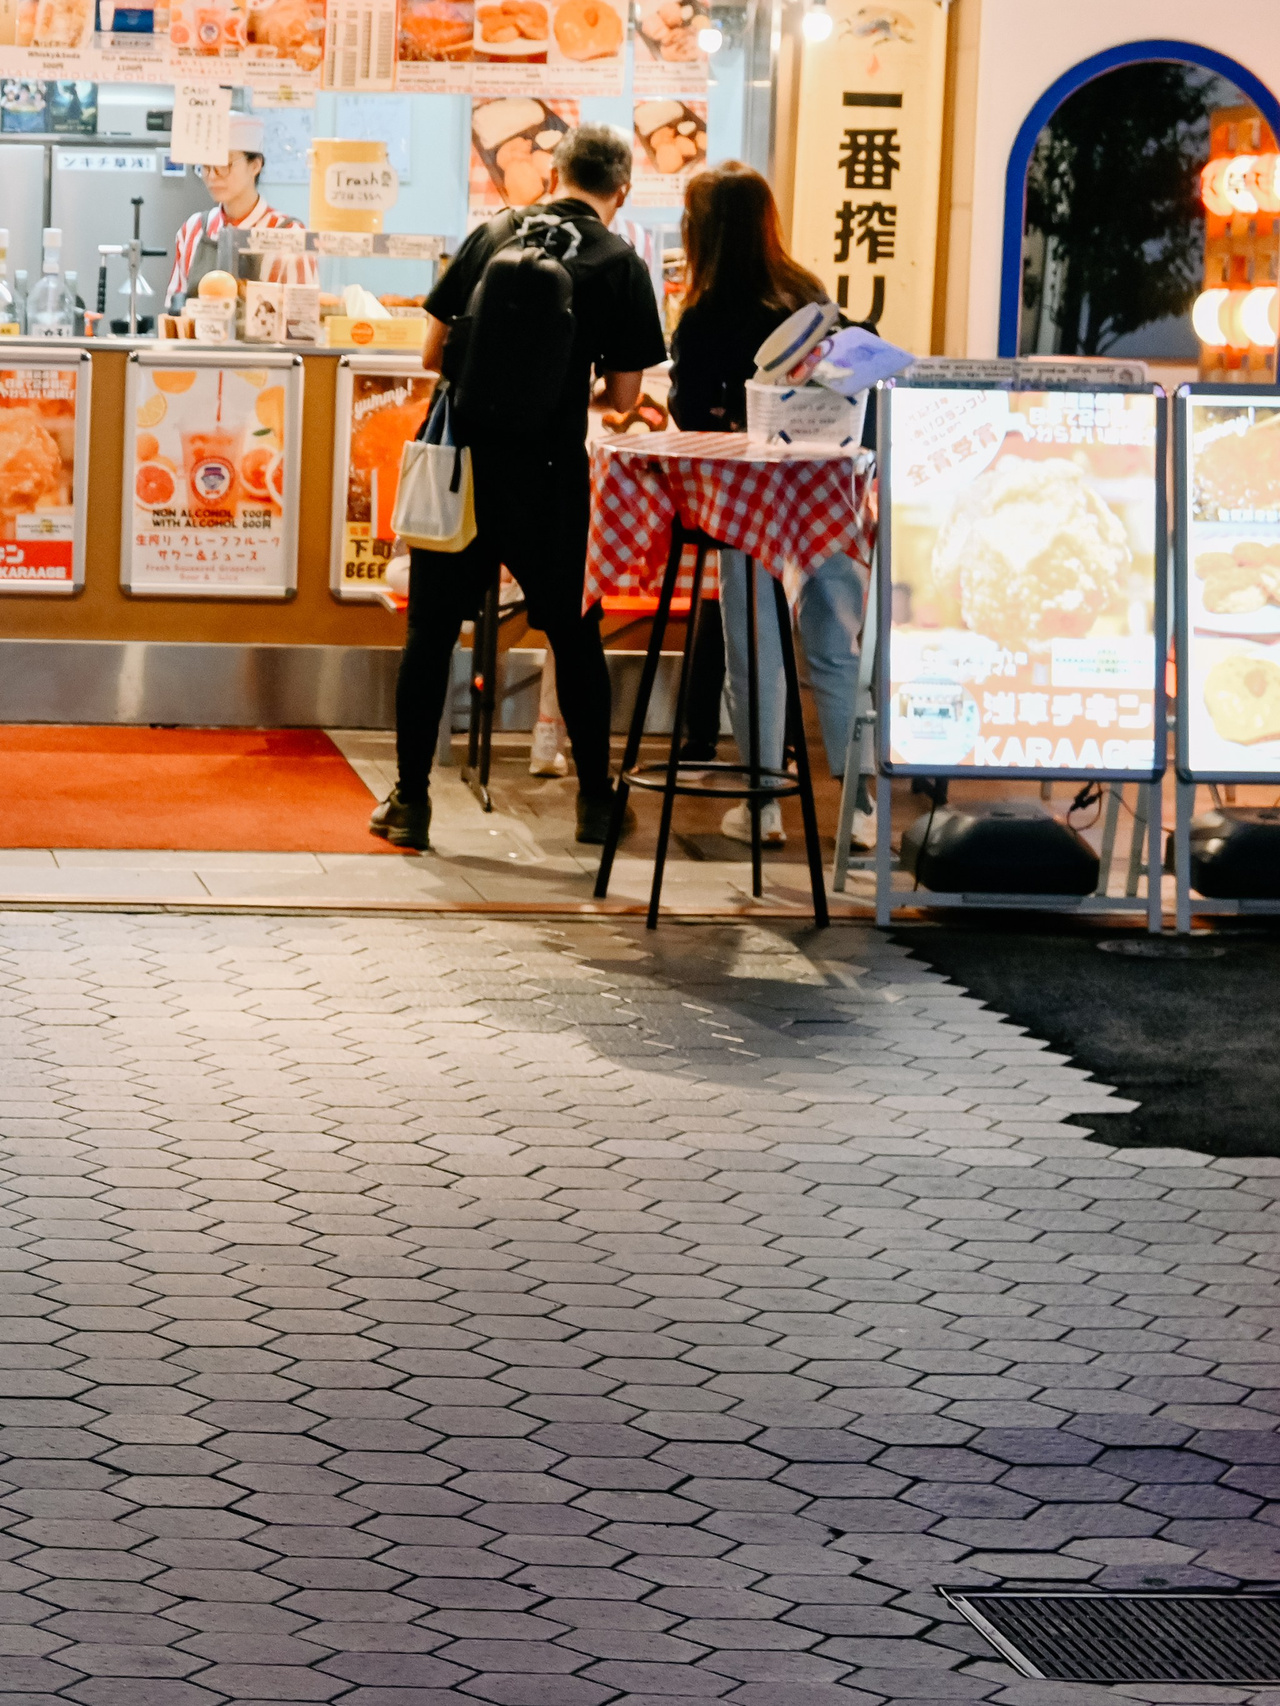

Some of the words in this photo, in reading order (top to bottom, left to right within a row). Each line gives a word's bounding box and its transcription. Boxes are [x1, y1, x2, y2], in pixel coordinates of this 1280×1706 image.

[331, 170, 379, 187] Trash
[834, 91, 903, 326] 一番搾り
[354, 377, 413, 420] yummy!
[906, 422, 998, 487] 金賞受賞
[152, 519, 180, 527] WITH
[185, 519, 237, 528] ALCOHOL
[153, 509, 176, 517] NON
[181, 509, 233, 518] ALCOHOL
[975, 736, 1155, 770] KARAAGE
